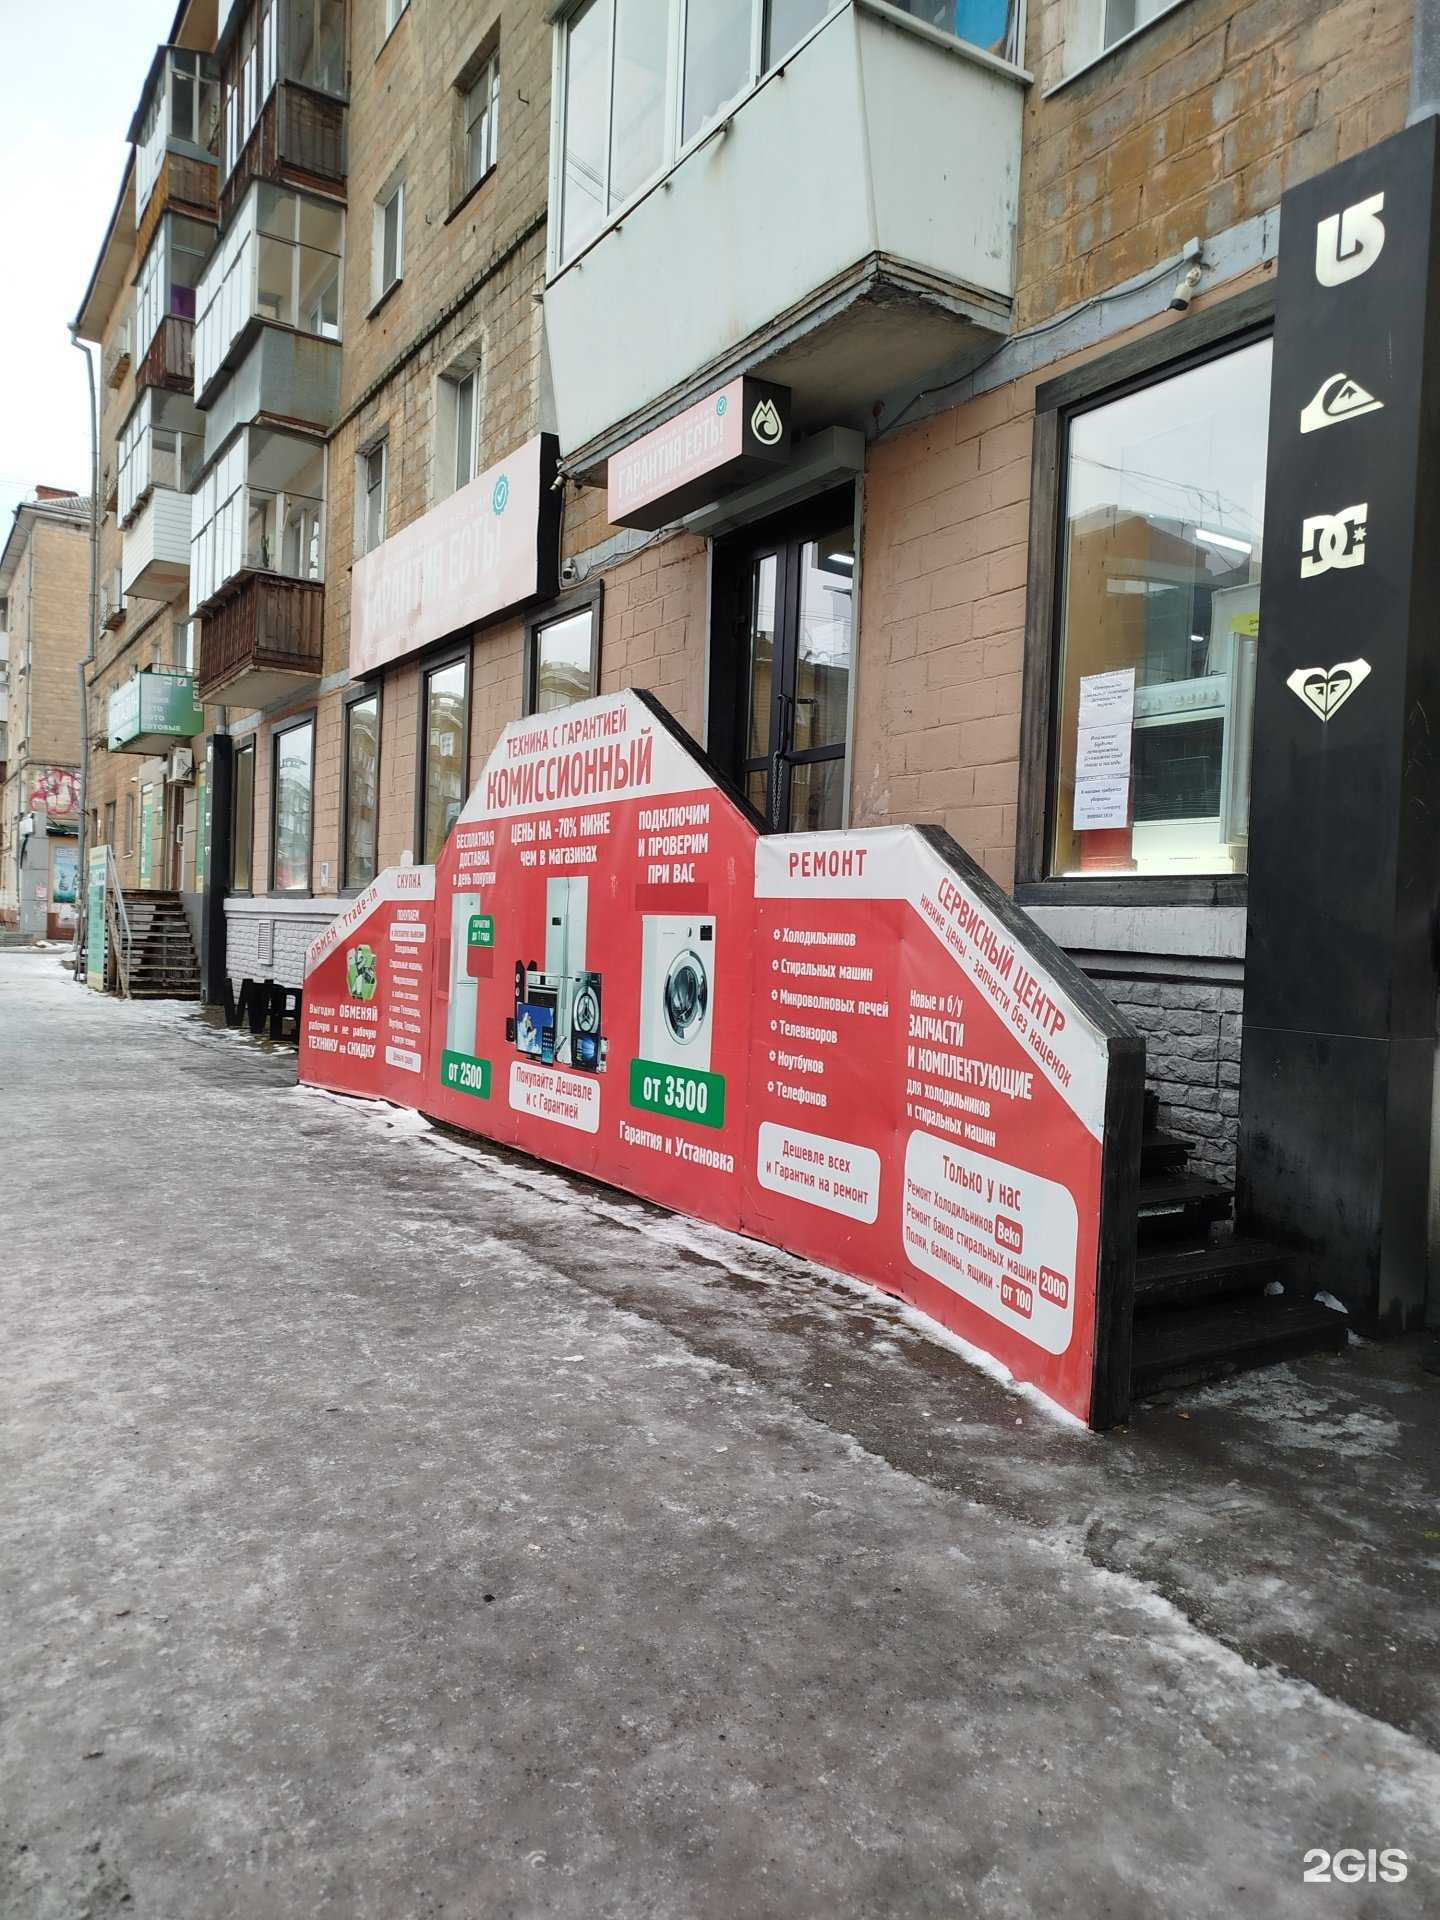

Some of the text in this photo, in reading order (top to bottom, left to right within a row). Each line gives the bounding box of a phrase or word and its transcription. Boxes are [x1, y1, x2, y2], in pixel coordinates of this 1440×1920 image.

[507, 705, 627, 759] ТЕХНИКА С ГАРАНТИЕЙ
[486, 727, 653, 810] КОМИССИОННЫЙ
[511, 811, 611, 847] ЦЕНЫ НА -70% НИЖЕ
[639, 803, 710, 832] ПОДКЛЮЧИМ
[456, 830, 495, 849] БЕСПЛАТНАЯ
[637, 834, 709, 857] И ПРОВЕРИМ
[459, 850, 490, 870] ДОСТАВКА
[520, 845, 598, 867] чем в магазинах
[788, 848, 868, 878] РЕМОНТ
[396, 872, 422, 889] СКУПКА
[647, 862, 695, 885] ПРИ ВАС
[310, 926, 337, 961] ОБМЕН
[342, 887, 378, 928] Trade-in
[782, 927, 856, 947] Холодильников
[780, 958, 873, 982] Стиральных машин
[936, 876, 1066, 1037] СЕРВИСНЫЙ ЦЕНТР
[779, 989, 889, 1018] Микроволновых печей
[909, 989, 963, 1018] Новые и б/у
[920, 894, 946, 931] низкие
[944, 924, 967, 958] цены
[972, 958, 1011, 1011] запчасти
[1009, 997, 1029, 1033] без
[1028, 1029, 1072, 1089] наценок
[309, 1004, 335, 1016] Выгодно
[339, 1004, 378, 1022] ОБМЕНЯЙ
[308, 1035, 338, 1053] ТЕХНИКУ
[347, 1041, 376, 1059] СКИДКУ
[779, 1019, 838, 1045] Телевизоров
[908, 1014, 965, 1048] ЗАПЧАСТИ
[448, 1062, 482, 1091] от 2500
[777, 1050, 824, 1074] Ноутбуков
[907, 1045, 1034, 1101] И КОМПЛЕКТУЮЩИЕ
[516, 1065, 593, 1101] Покупайте Дешевле
[643, 1075, 708, 1114] от 3500
[776, 1079, 828, 1108] Телефонов
[906, 1078, 992, 1118] для холодильников
[526, 1093, 531, 1105] и
[539, 1092, 579, 1121] Гарантией
[906, 1104, 996, 1149] и стиральных машин
[618, 1120, 735, 1173] Гарантия и Установка
[782, 1140, 851, 1174] Дешевле всех
[766, 1160, 869, 1206] и Гарантия на ремонт
[941, 1154, 1021, 1212] Только у нас
[906, 1178, 1021, 1248] Ремонт Холодильников Beko
[906, 1202, 1066, 1303] Ремонт баков стиральных машин 2000
[967, 1261, 994, 1290] ящики
[1002, 1286, 1012, 1304] от
[1014, 1285, 1031, 1313] 100
